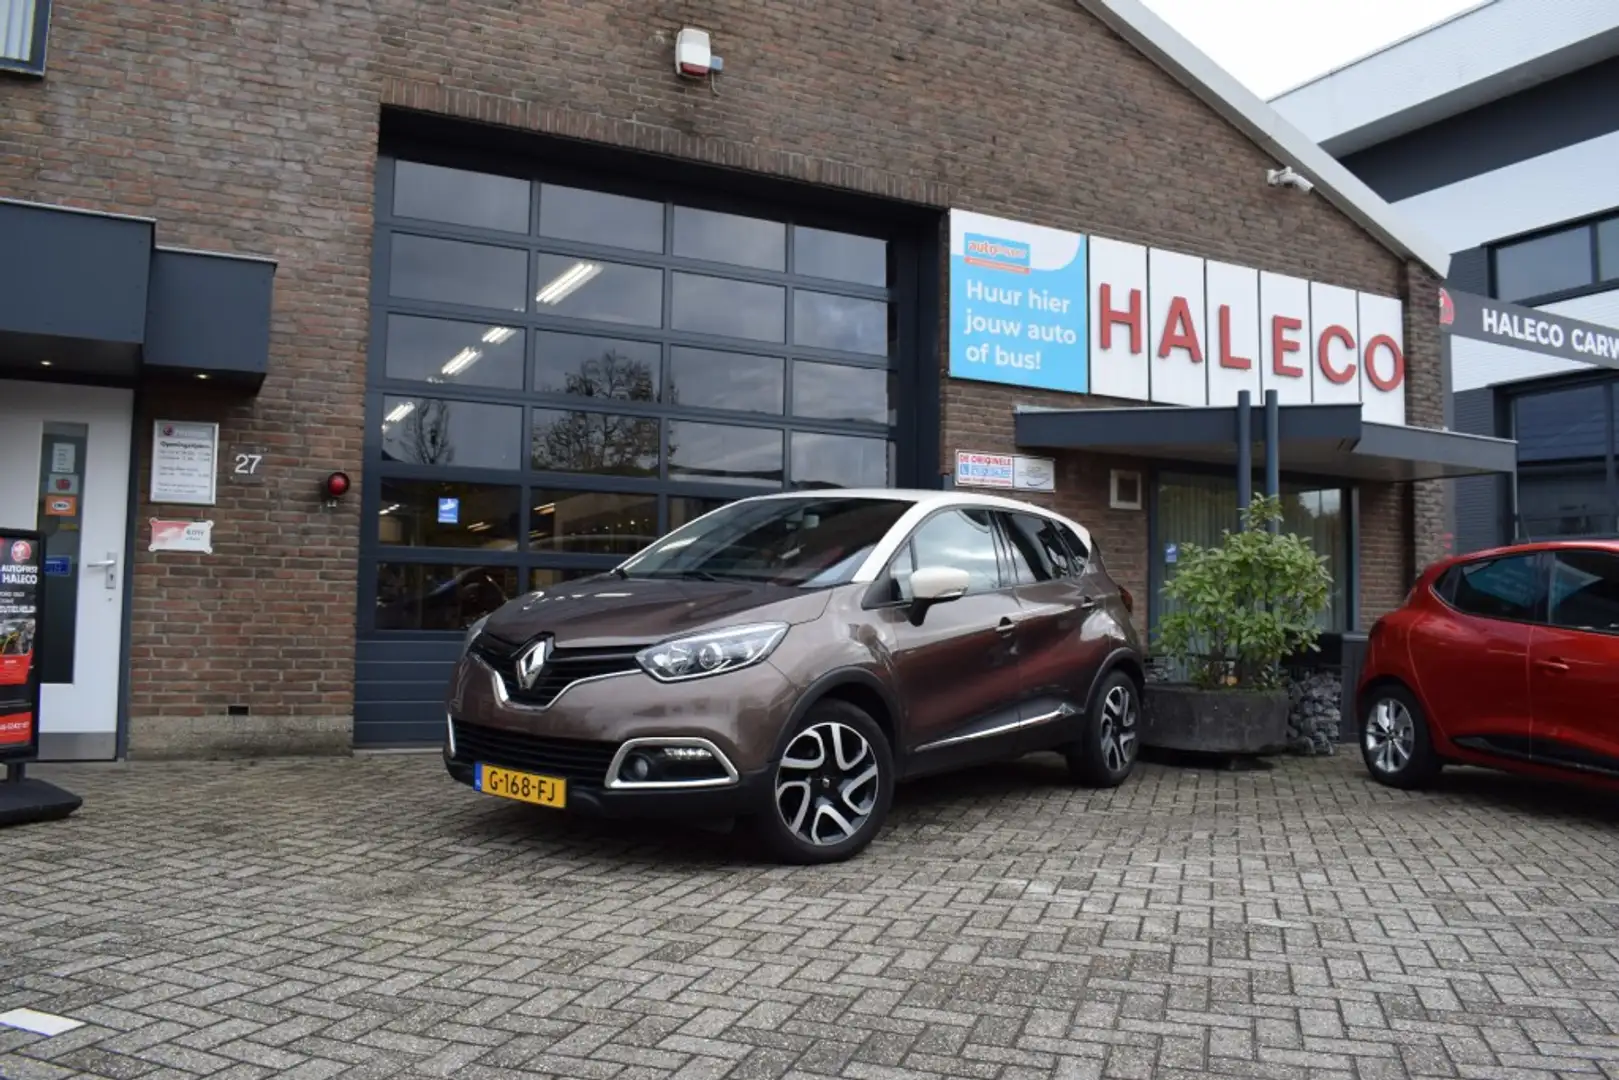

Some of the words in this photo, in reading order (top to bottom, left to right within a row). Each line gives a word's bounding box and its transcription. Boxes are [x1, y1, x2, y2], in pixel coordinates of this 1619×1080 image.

[966, 279, 1023, 306] Huur
[1028, 288, 1071, 314] hier
[963, 308, 1021, 337] jouw
[1027, 323, 1077, 344] auto
[1099, 282, 1406, 393] HALECO
[1481, 308, 1565, 348] HALECO
[965, 343, 989, 364] of
[995, 344, 1041, 370] bus!
[234, 453, 262, 474] 27
[2, 573, 38, 585] HALECO
[489, 770, 555, 802] G-168-FJ
